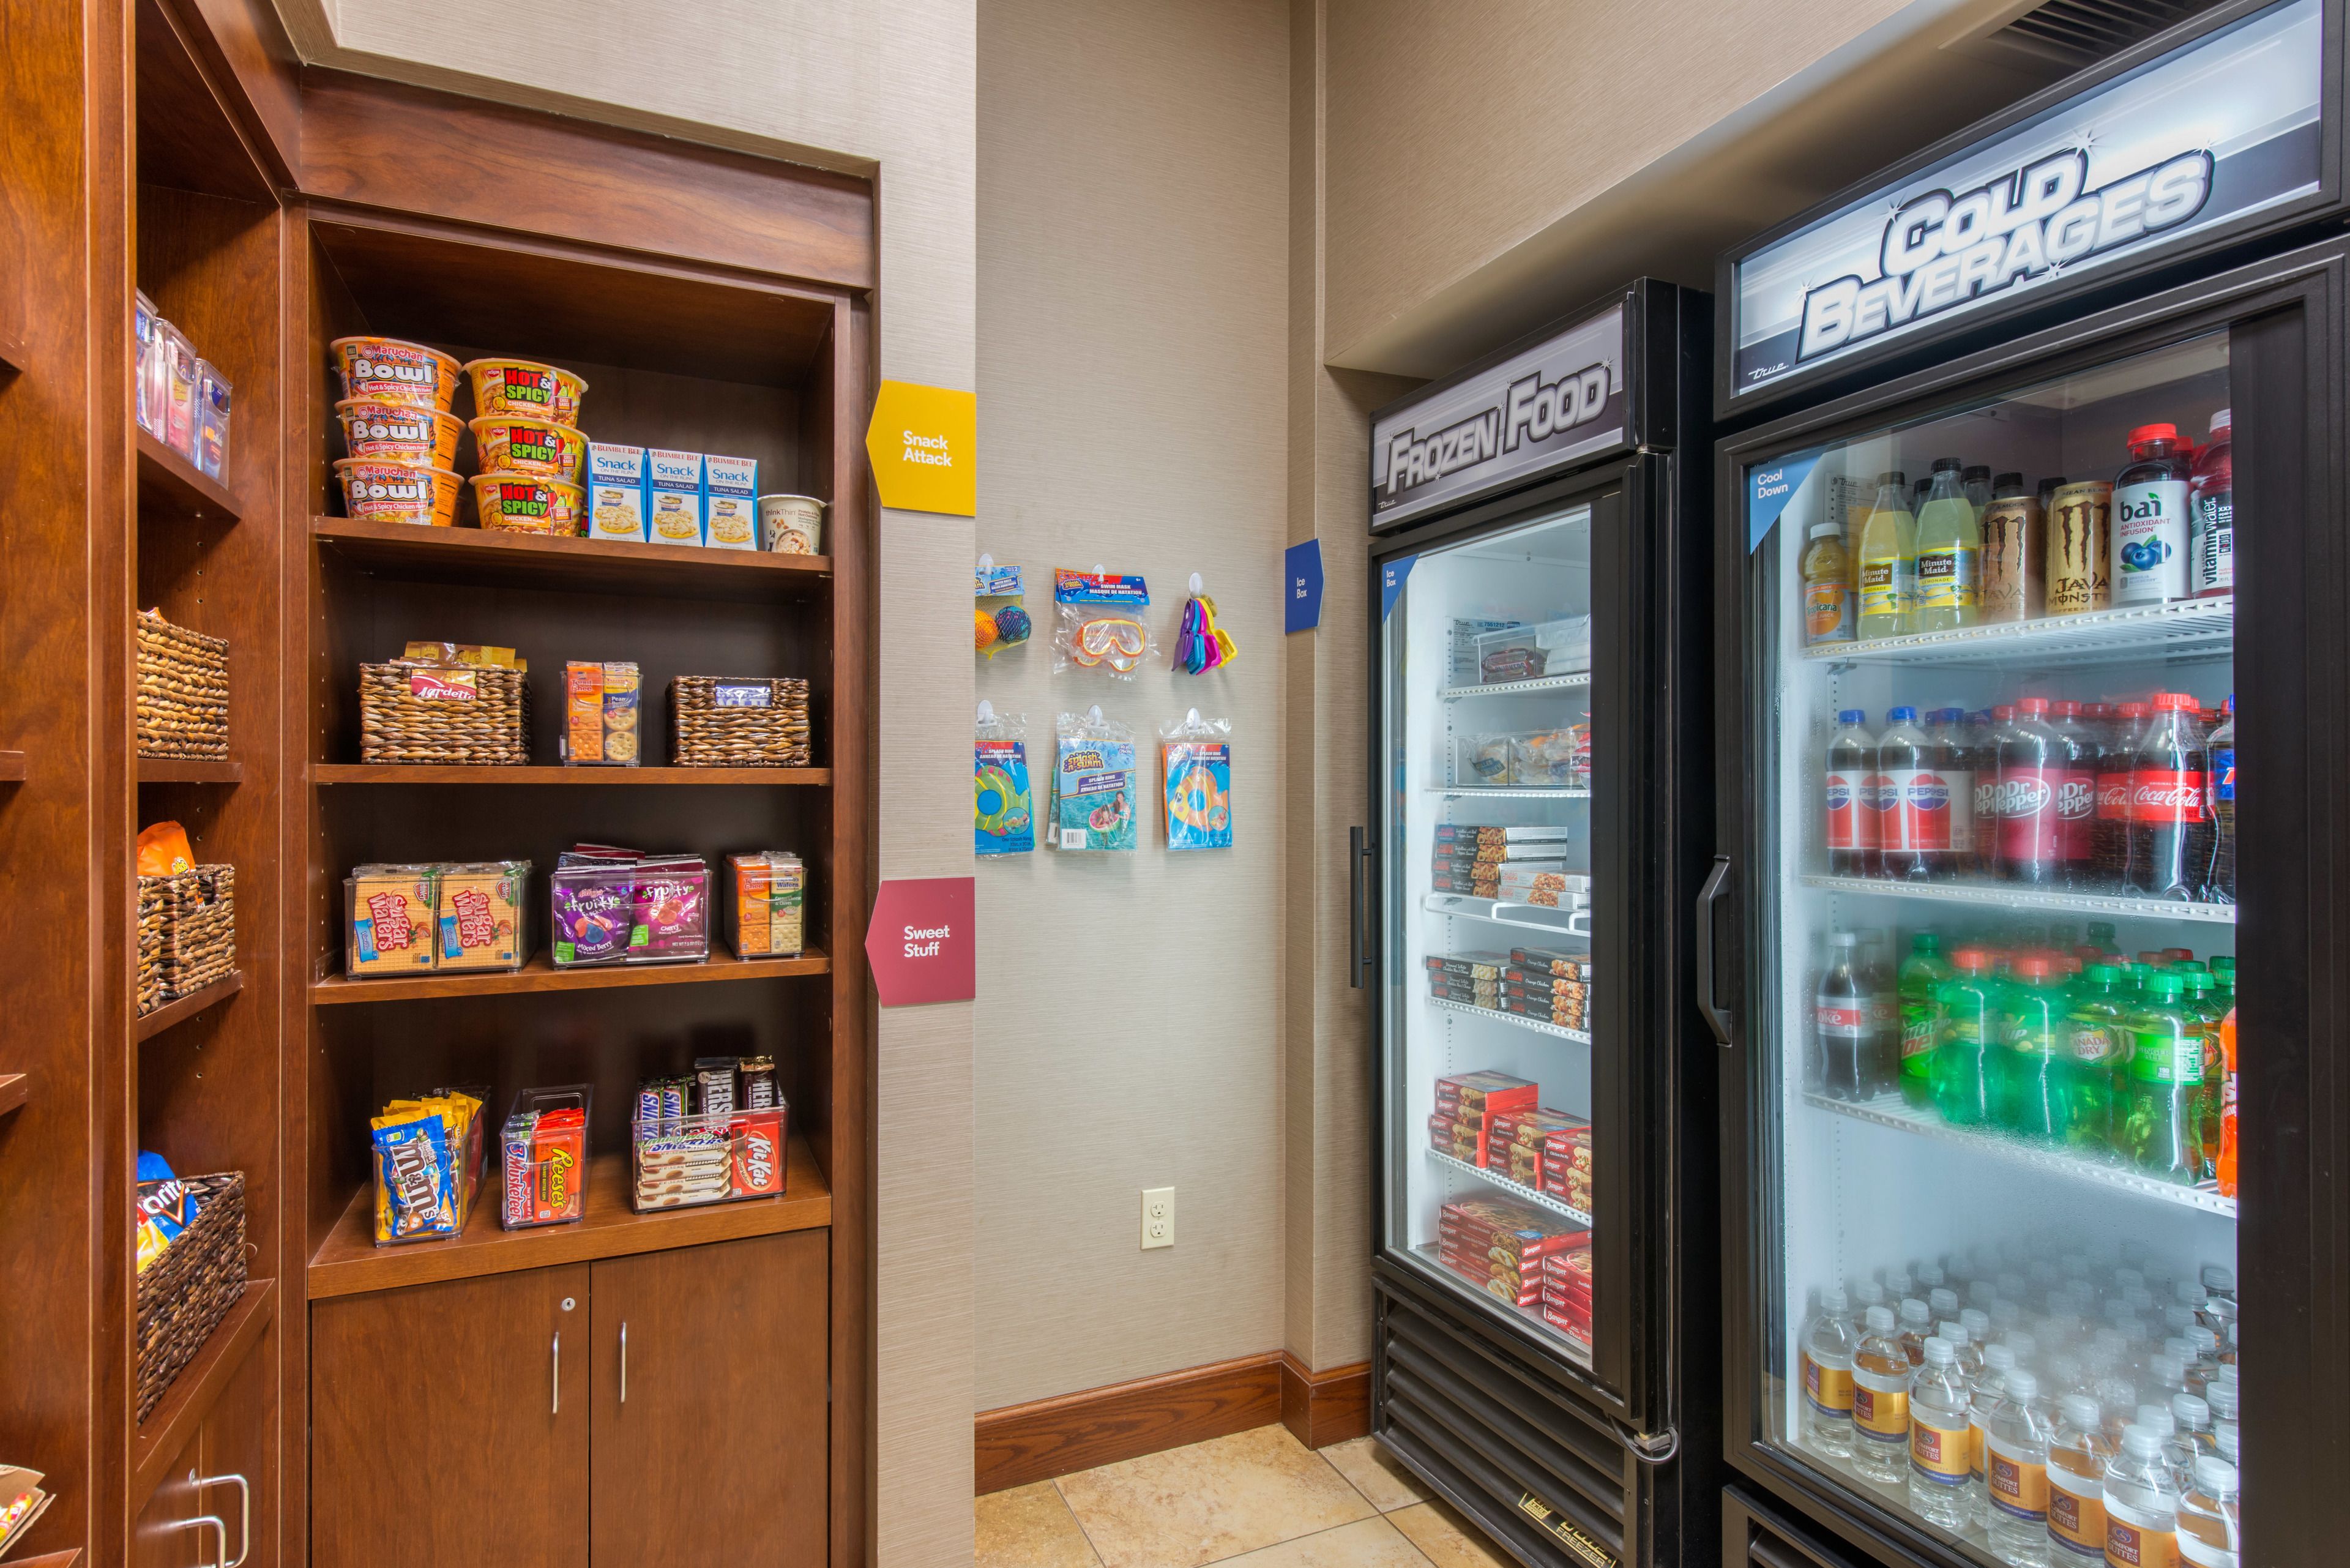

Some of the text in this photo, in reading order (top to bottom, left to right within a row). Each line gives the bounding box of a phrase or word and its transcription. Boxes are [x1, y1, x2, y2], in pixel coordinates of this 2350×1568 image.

[1880, 149, 2087, 277] COLD
[1797, 149, 2214, 363] BEVERAGES
[372, 345, 423, 362] Maruchan
[355, 359, 433, 384] Bowl
[505, 370, 551, 389] HOT &
[384, 384, 398, 392] Spicy
[507, 385, 551, 403] SPICY
[367, 406, 417, 419] Maruchan
[352, 420, 428, 441] Bowl
[1387, 362, 1611, 495] FROZEN FOOD
[511, 428, 556, 447] HOT &
[903, 430, 948, 450] Snack
[511, 444, 556, 460] SPICY
[597, 444, 626, 453] BUMBLE
[597, 457, 636, 471] Snack
[903, 447, 952, 467] Attack
[365, 466, 416, 478] Maruchan
[657, 463, 695, 476] Snack
[713, 469, 748, 482] Snack
[1758, 469, 1782, 485] Cool
[351, 480, 427, 499] Bowl
[502, 485, 547, 501] HOT &
[1758, 483, 1788, 499] Down
[502, 500, 547, 515] SPICY
[2120, 493, 2162, 522] bai
[2121, 518, 2171, 531] ANTIOXIDANT
[2121, 526, 2154, 537] INFUSION
[1921, 559, 1952, 569] Minute
[1923, 566, 1949, 575] Maid
[1862, 568, 1889, 577] Minute
[1863, 575, 1885, 584] Maid
[1387, 578, 1396, 587] Box
[2056, 572, 2109, 594] JAVA
[1297, 589, 1307, 599] Box
[1807, 603, 1837, 615] Tropicana
[1068, 753, 1097, 765] splash
[2006, 781, 2030, 798] Dr
[2063, 783, 2087, 798] Dr
[2134, 786, 2201, 807] Coca-Cola
[368, 894, 393, 950] Wafers
[453, 892, 477, 946] Wafers
[904, 925, 950, 939] Sweet
[597, 941, 612, 950] Berry
[904, 942, 939, 957] Stuff
[2078, 1045, 2100, 1055] DRY
[1494, 1119, 1510, 1127] Banquet
[510, 1145, 523, 1155] 3
[1546, 1140, 1565, 1149] Banquet
[551, 1148, 574, 1209] Reese's
[1524, 1245, 1541, 1255] Banquet
[1521, 1261, 1538, 1270] Banquet
[1547, 1263, 1567, 1275] Banquet
[1524, 1277, 1541, 1286] Banquet
[1548, 1277, 1567, 1289] Banquet
[1520, 1294, 1537, 1304] Banquet
[1546, 1294, 1565, 1305] Banquet
[1548, 1311, 1568, 1325] Banquet
[1915, 1445, 1939, 1461] SUITES
[1991, 1471, 2018, 1487] COMFORT
[1992, 1479, 2018, 1495] SUITES
[2051, 1503, 2077, 1521] COMFORT
[2051, 1512, 2077, 1529] SUITES
[1556, 1527, 1605, 1567] FREEZER
[2108, 1534, 2138, 1555] COMFORT
[2108, 1542, 2138, 1562] SUITES
